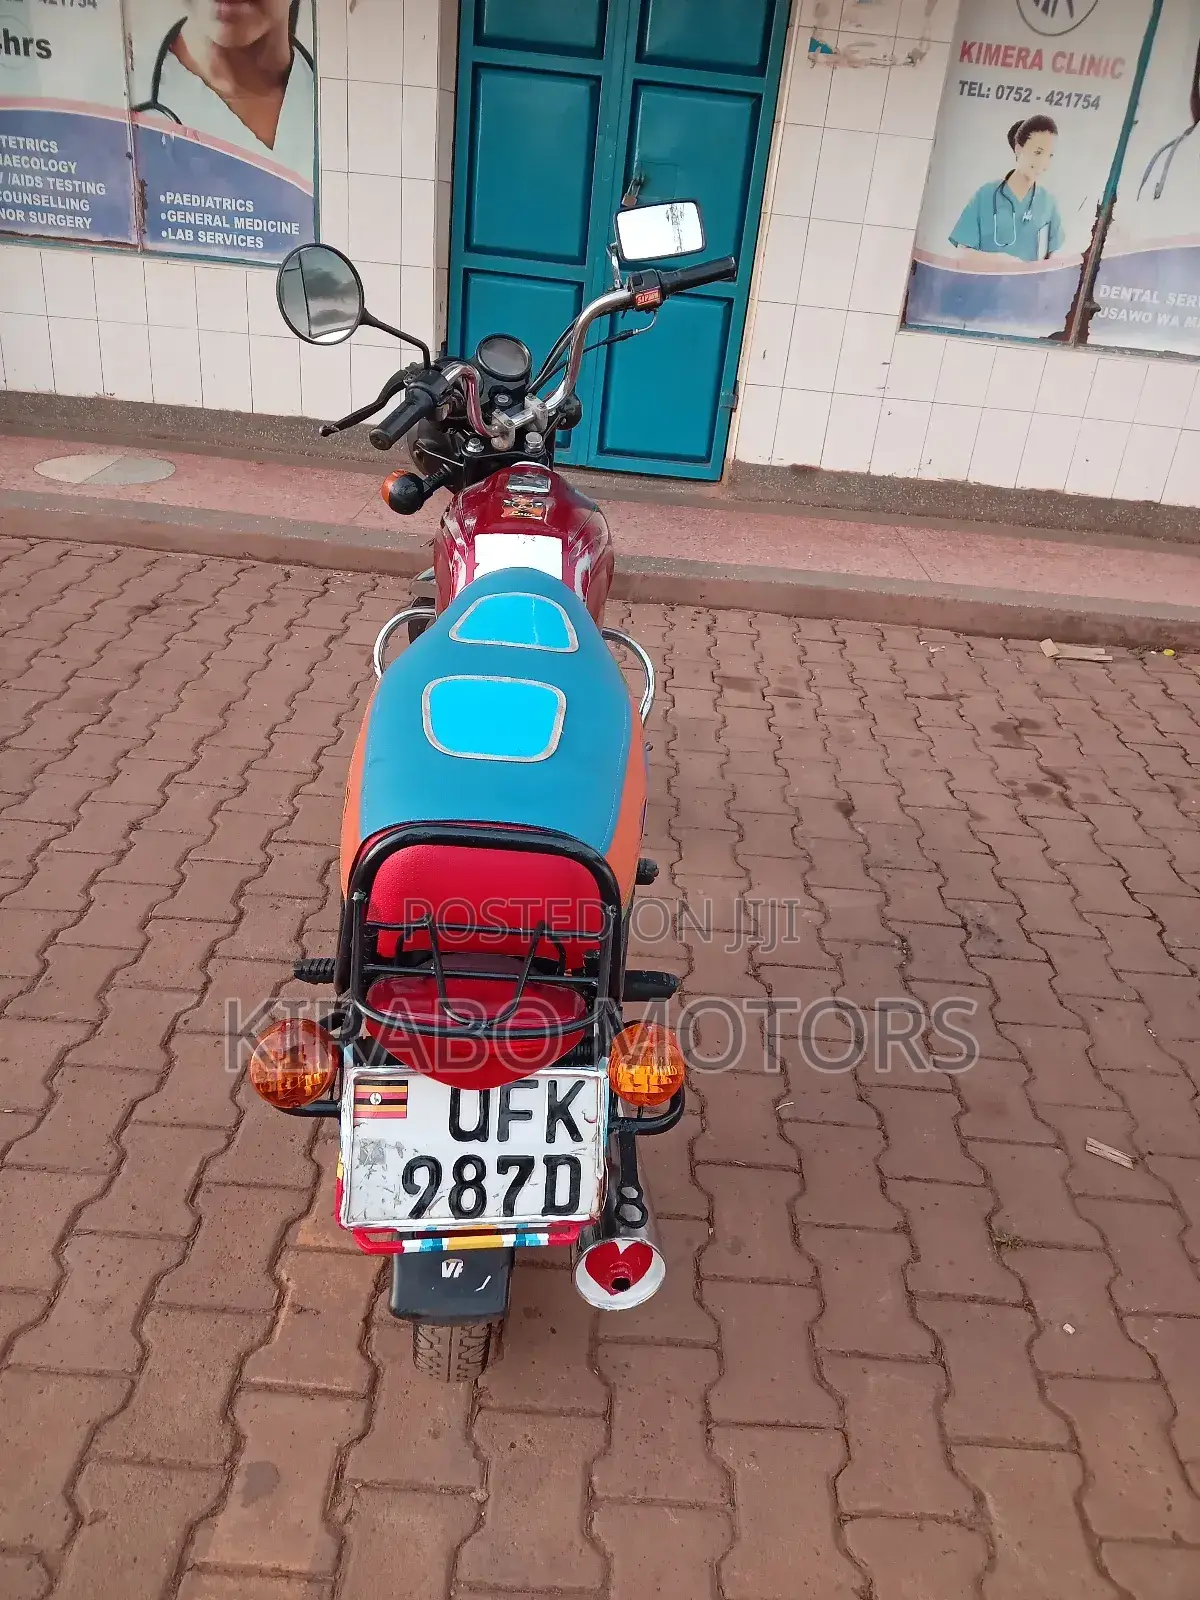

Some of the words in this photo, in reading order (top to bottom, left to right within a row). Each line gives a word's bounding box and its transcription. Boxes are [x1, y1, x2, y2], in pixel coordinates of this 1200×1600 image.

[958, 40, 1044, 71] KIMERA
[1051, 50, 1126, 79] CLINIC
[958, 79, 991, 99] TEL:
[995, 84, 1033, 103] 0752
[1045, 90, 1102, 111] 421754
[0, 153, 77, 174] AECOLOGY
[47, 176, 107, 196] TESTING
[0, 190, 90, 212] OUNSELLING
[166, 191, 255, 213] PAEDIATRICS
[29, 210, 92, 230] SURGERY
[166, 209, 231, 229] GENERAL
[234, 216, 300, 236] MEDICINE
[168, 227, 194, 242] LAB
[197, 230, 264, 249] SERVICES
[1099, 284, 1160, 304] DENTAL
[1095, 305, 1153, 324] USAWO
[1157, 311, 1180, 328] WA
[448, 1079, 585, 1144] UFK
[401, 1154, 582, 1220] 987D
